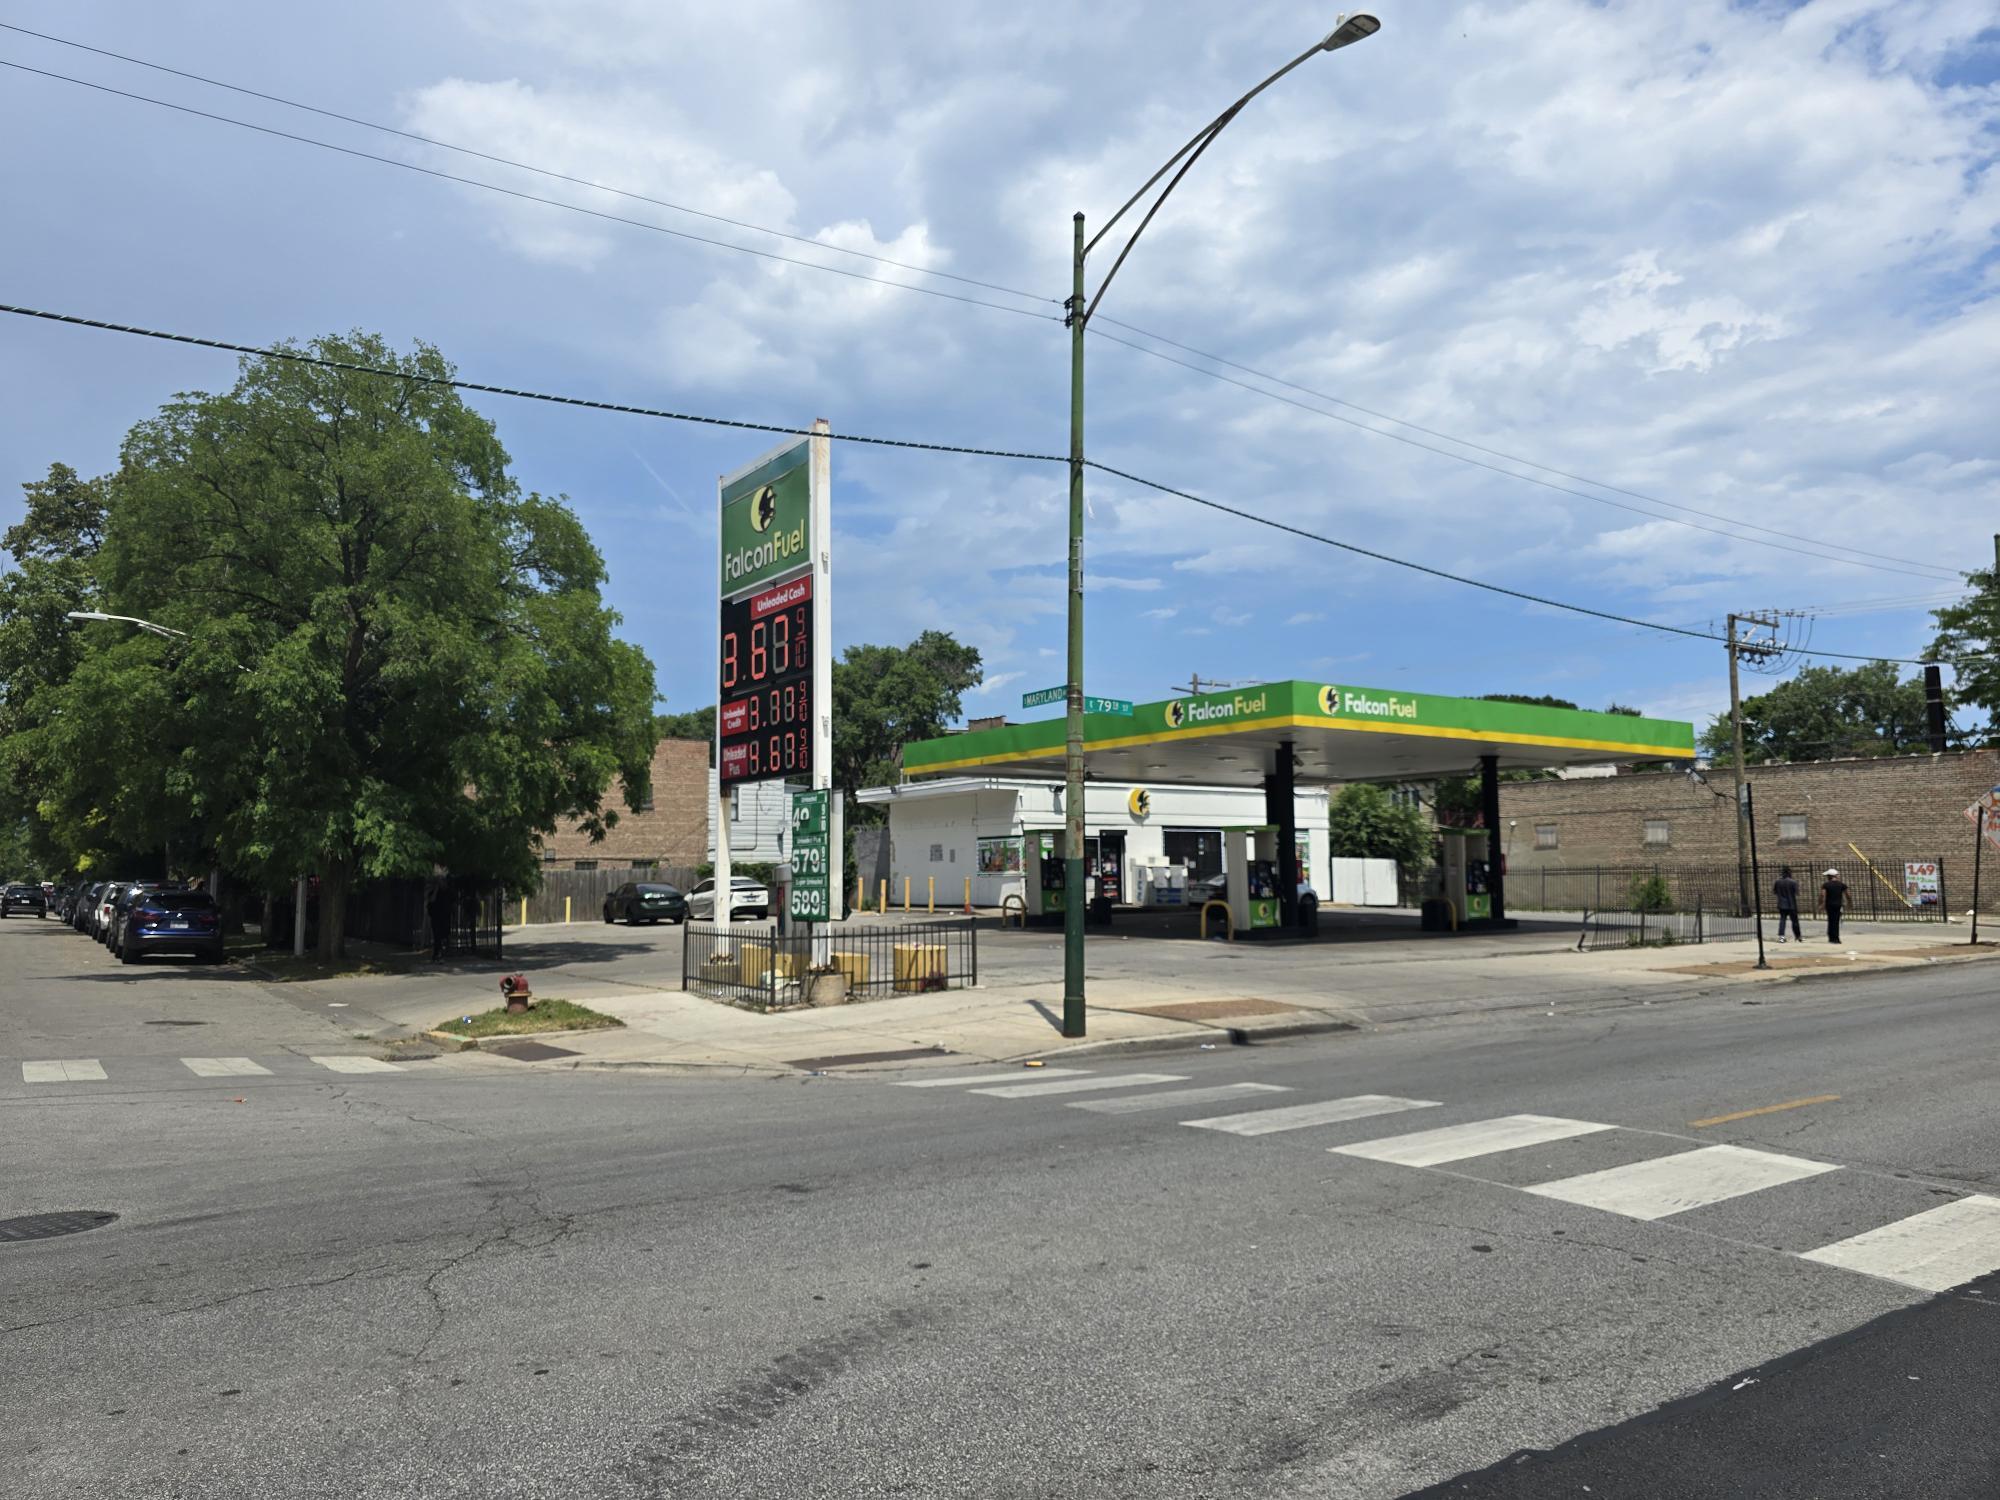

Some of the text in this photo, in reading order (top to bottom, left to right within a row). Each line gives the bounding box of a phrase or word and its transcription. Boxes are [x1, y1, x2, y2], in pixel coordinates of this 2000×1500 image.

[725, 519, 805, 582] FalconFuel
[756, 584, 805, 612] Unleaded Cash
[723, 614, 789, 688] 3.67
[1026, 688, 1063, 705] MARYLAND
[1188, 692, 1267, 722] FalconFuel
[1344, 692, 1418, 718] FalconFuel
[791, 848, 820, 873] 579
[791, 890, 820, 915] 589
